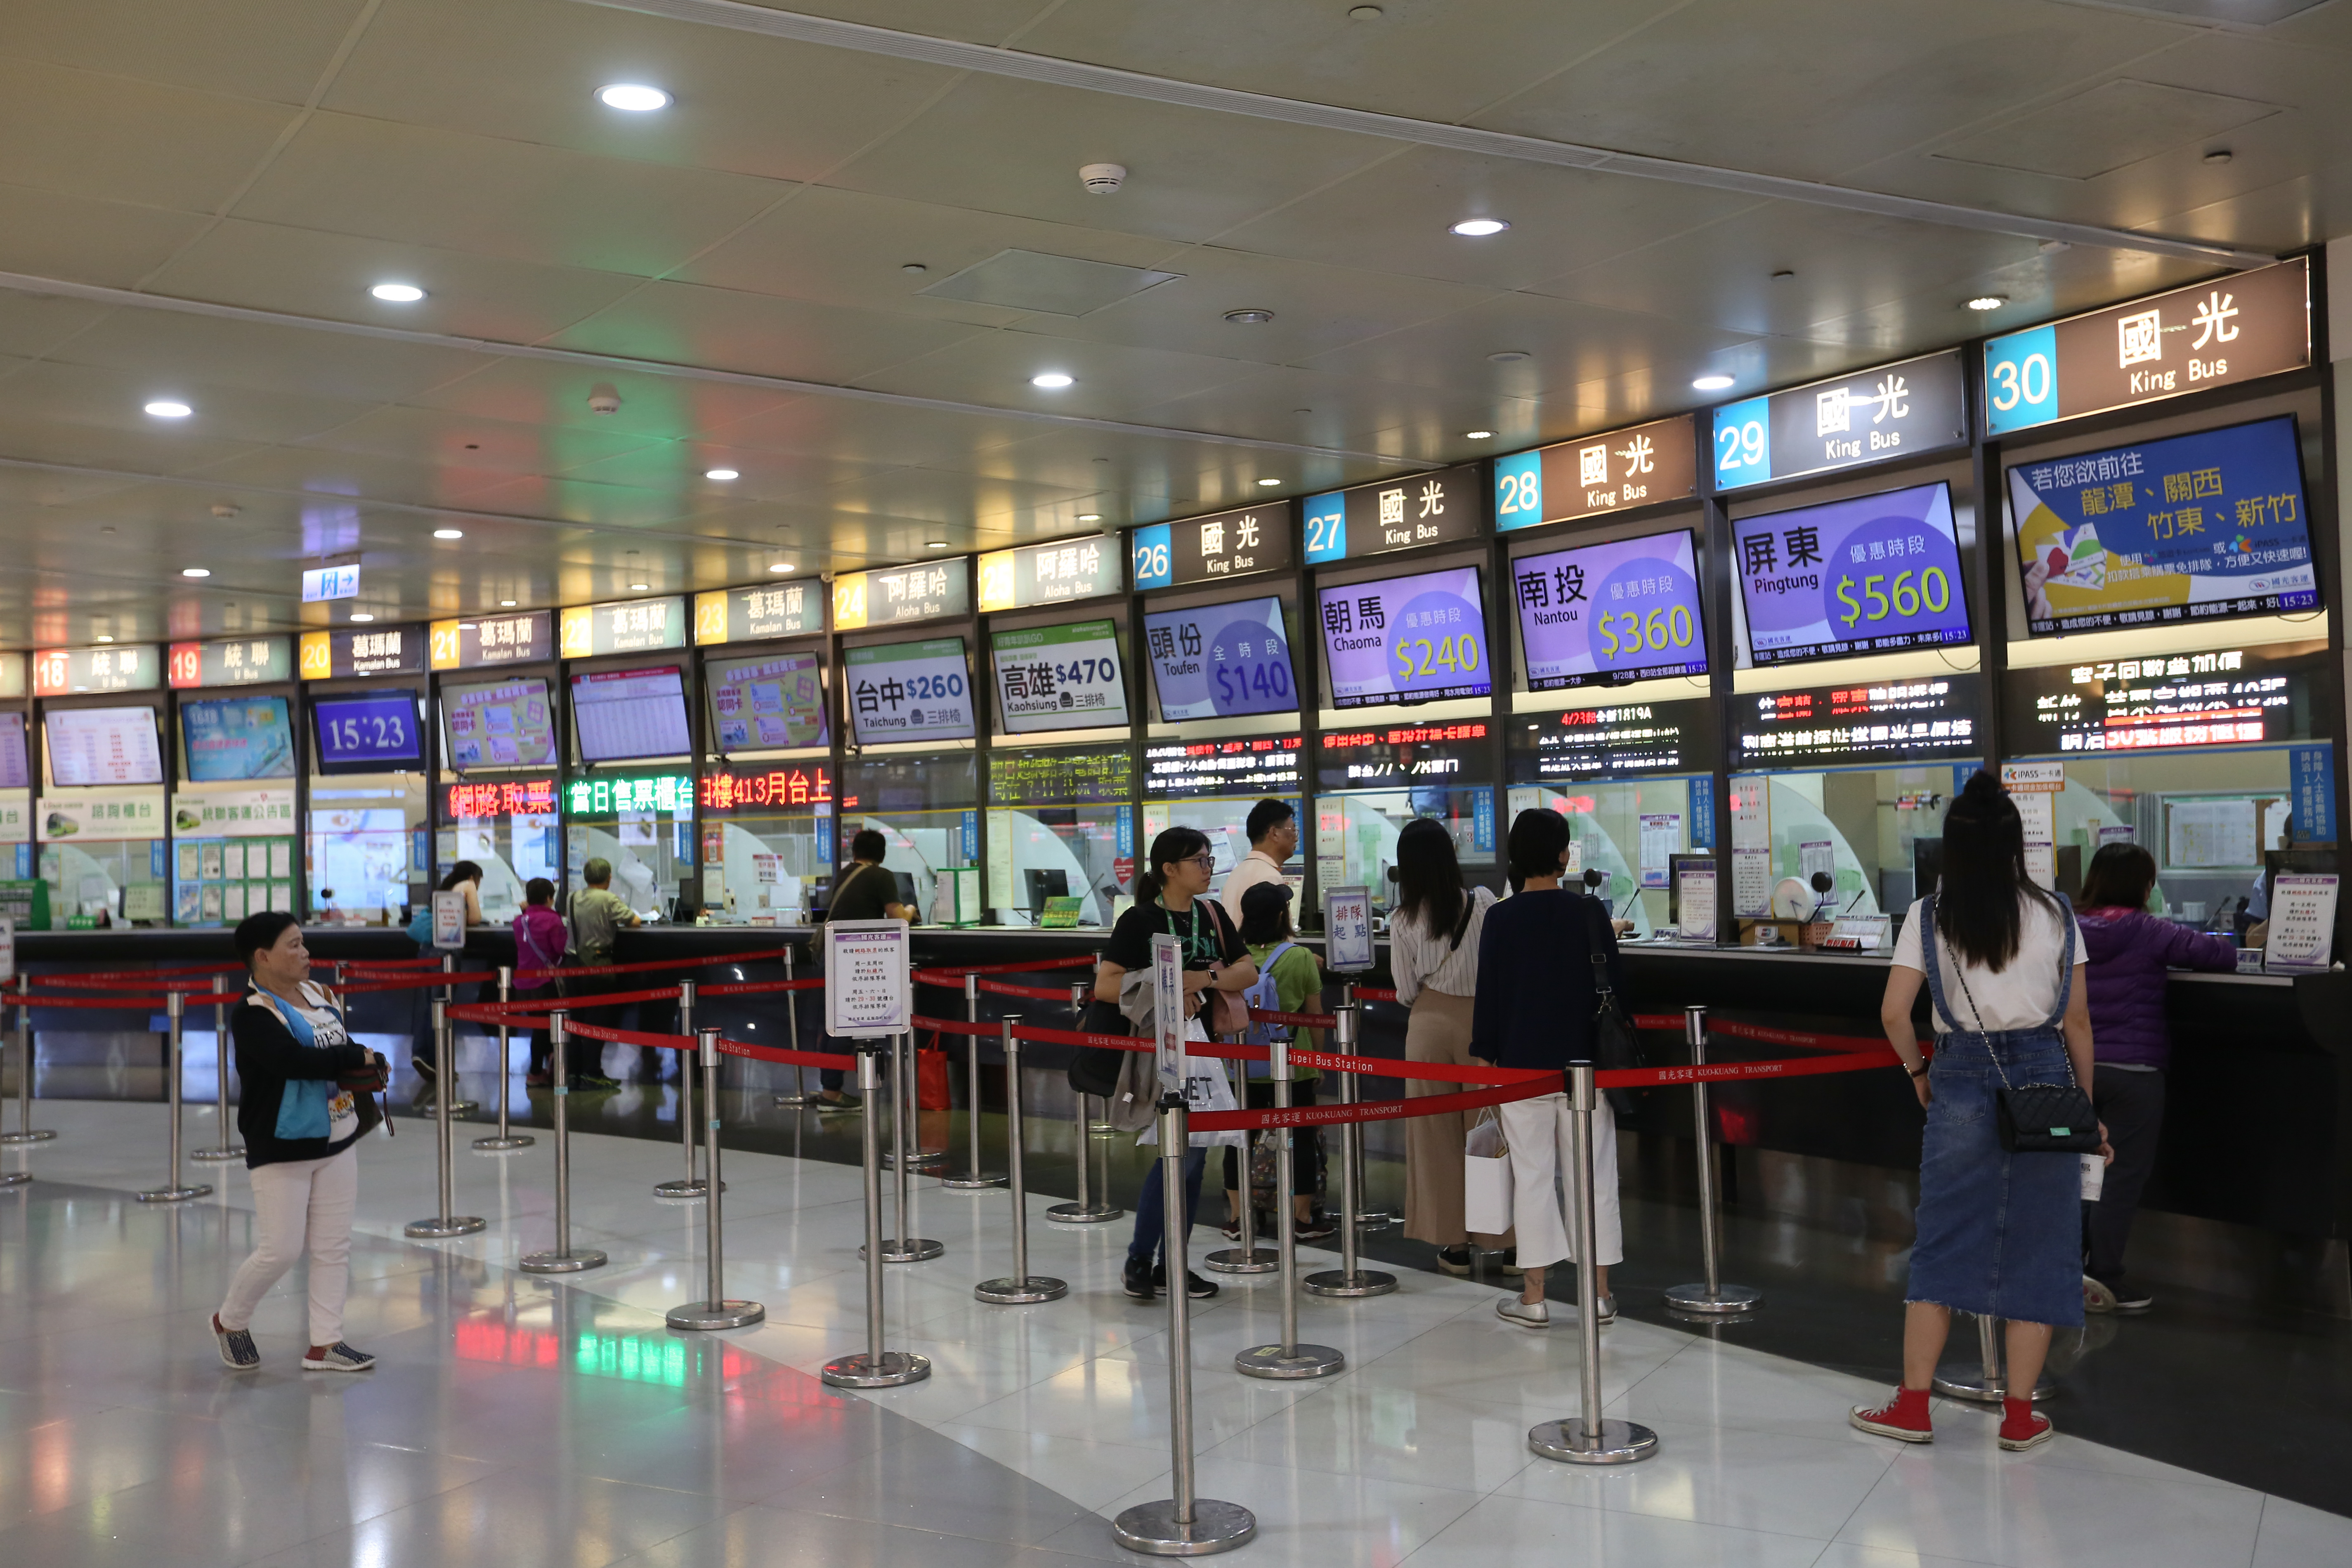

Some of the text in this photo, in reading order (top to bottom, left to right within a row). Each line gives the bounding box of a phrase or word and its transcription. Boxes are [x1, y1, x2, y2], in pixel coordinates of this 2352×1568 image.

[2118, 291, 2239, 369] 國光
[1992, 353, 2050, 411] 30
[2130, 357, 2227, 394] King Bus
[1816, 374, 1909, 437] 國光
[1719, 421, 1764, 470] 29
[1825, 431, 1901, 459] King Bus
[1579, 434, 1654, 487] 國光
[2032, 451, 2144, 491] 若您欲前往
[1379, 480, 1444, 527] 國光
[1500, 470, 1538, 515] 28
[1587, 484, 1647, 508] King Bus
[1201, 515, 1259, 556] 國光
[1308, 513, 1341, 552] 27
[1385, 524, 1438, 545] King Bus
[1037, 543, 1100, 582] 阿羅哈
[1137, 544, 1168, 579] 26
[1743, 525, 1823, 575] 屏東
[1850, 535, 1925, 564] 優惠時段
[2120, 552, 2143, 567] 使用
[2213, 541, 2226, 554] 或
[1207, 555, 1254, 573] King Bus
[888, 567, 947, 602] 阿羅哈
[983, 564, 1011, 600] 25
[1045, 581, 1092, 598] Aloha Bus
[1518, 564, 1587, 609] 南投
[1611, 576, 1674, 600] 優惠時段
[1754, 574, 1818, 594] Pingtung
[748, 586, 803, 619] 葛瑪蘭
[838, 586, 864, 620] 24
[895, 602, 940, 618] Aloha Bus
[1836, 566, 1949, 628] $560
[2283, 595, 2313, 608] 15:23
[612, 603, 666, 634] 葛瑪蘭
[700, 603, 724, 635] 23
[750, 619, 801, 635] Kamalan Bus
[1324, 596, 1385, 635] 朝馬
[1406, 607, 1461, 628] 優惠時段
[1534, 610, 1578, 626] Nantou
[352, 631, 401, 658] 葛瑪蘭
[435, 630, 456, 660] 21
[479, 618, 533, 647] 葛瑪蘭
[566, 618, 589, 648] 22
[614, 633, 664, 649] Kamalan Bus
[1149, 623, 1202, 659] 頭份
[1334, 636, 1381, 651] Chaoma
[1598, 605, 1693, 660] $360
[1944, 629, 1967, 640] 15:23
[303, 644, 328, 669] 20
[354, 657, 401, 671] Kamalan Bus
[482, 646, 530, 660] Kamalan Bus
[1213, 639, 1278, 661] 全時段
[1396, 633, 1478, 682] $240
[40, 659, 64, 687] 18
[174, 651, 197, 680] 19
[234, 669, 241, 680] U
[1001, 658, 1115, 700] 高雄 $470
[1163, 661, 1200, 676] Toufen
[1688, 664, 1707, 674] 15:23
[855, 673, 963, 713] 台中 $260
[1216, 661, 1288, 706] $140
[1475, 686, 1490, 695] 15:23
[1008, 693, 1105, 712] Kaohsiung 三排椅
[864, 708, 960, 727] Taichung 三排椅
[329, 716, 404, 750] 15:23
[2018, 769, 2061, 778] iPASS 一卡通
[450, 779, 552, 818] 網路取票
[571, 776, 693, 814] 當日售票櫃台
[1336, 904, 1363, 921] 排隊
[1333, 924, 1366, 940] 起點
[1164, 1003, 1176, 1024] 入口
[601, 1030, 618, 1040] Station
[718, 1040, 750, 1056] Bus Station
[1088, 1036, 1109, 1045] 國光客運
[1111, 1039, 1136, 1047] KUO-KUANG
[1288, 1052, 1373, 1072] aipei Bus Station
[1659, 1064, 1782, 1080] 國光客運 KUO-KUANG TRANSPORT
[1262, 1105, 1403, 1124] 國光客運 KUO-KUANG TRANSPORT
